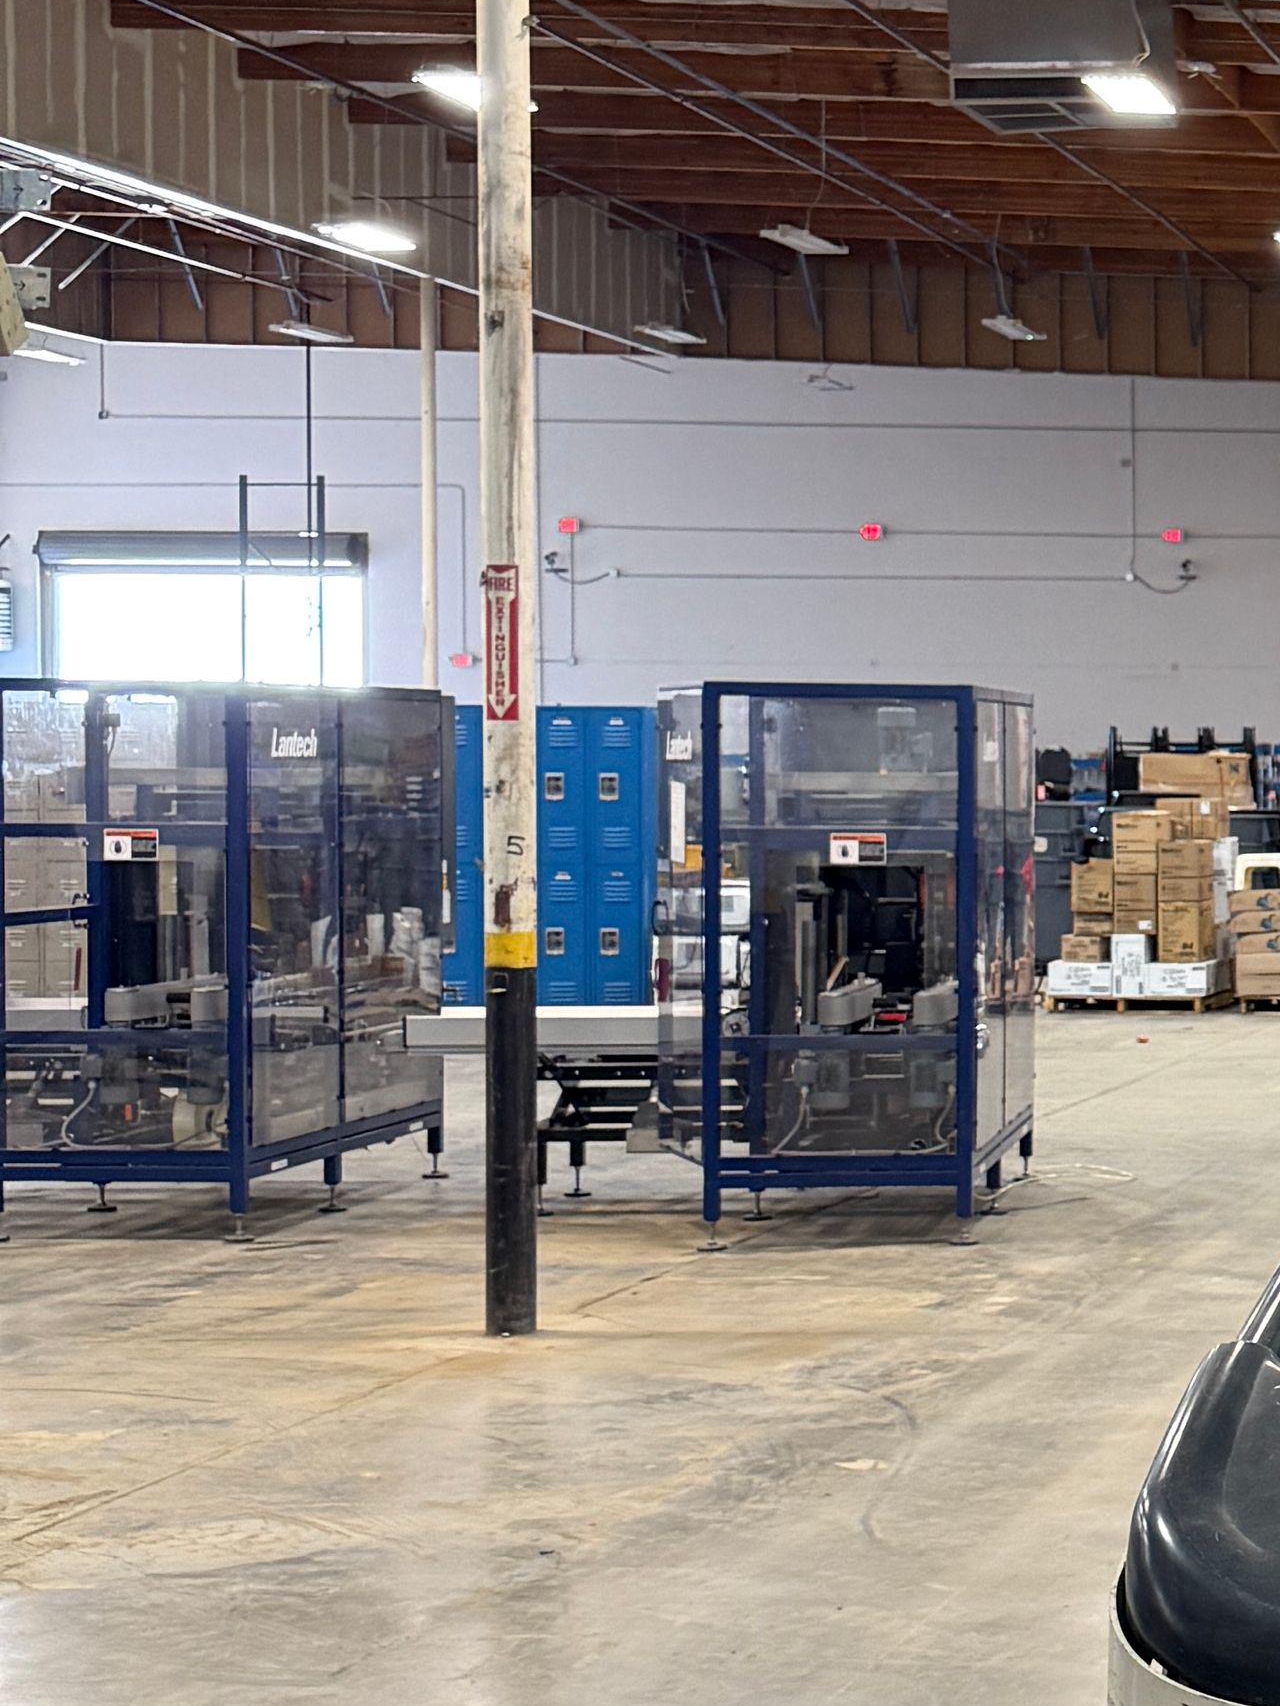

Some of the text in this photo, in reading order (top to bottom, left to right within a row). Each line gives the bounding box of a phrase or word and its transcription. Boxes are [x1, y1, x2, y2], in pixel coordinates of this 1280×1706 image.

[488, 577, 513, 592] FIRE
[495, 596, 506, 707] EXTINGUISHER
[271, 727, 318, 758] Lantech
[506, 835, 526, 856] 5
